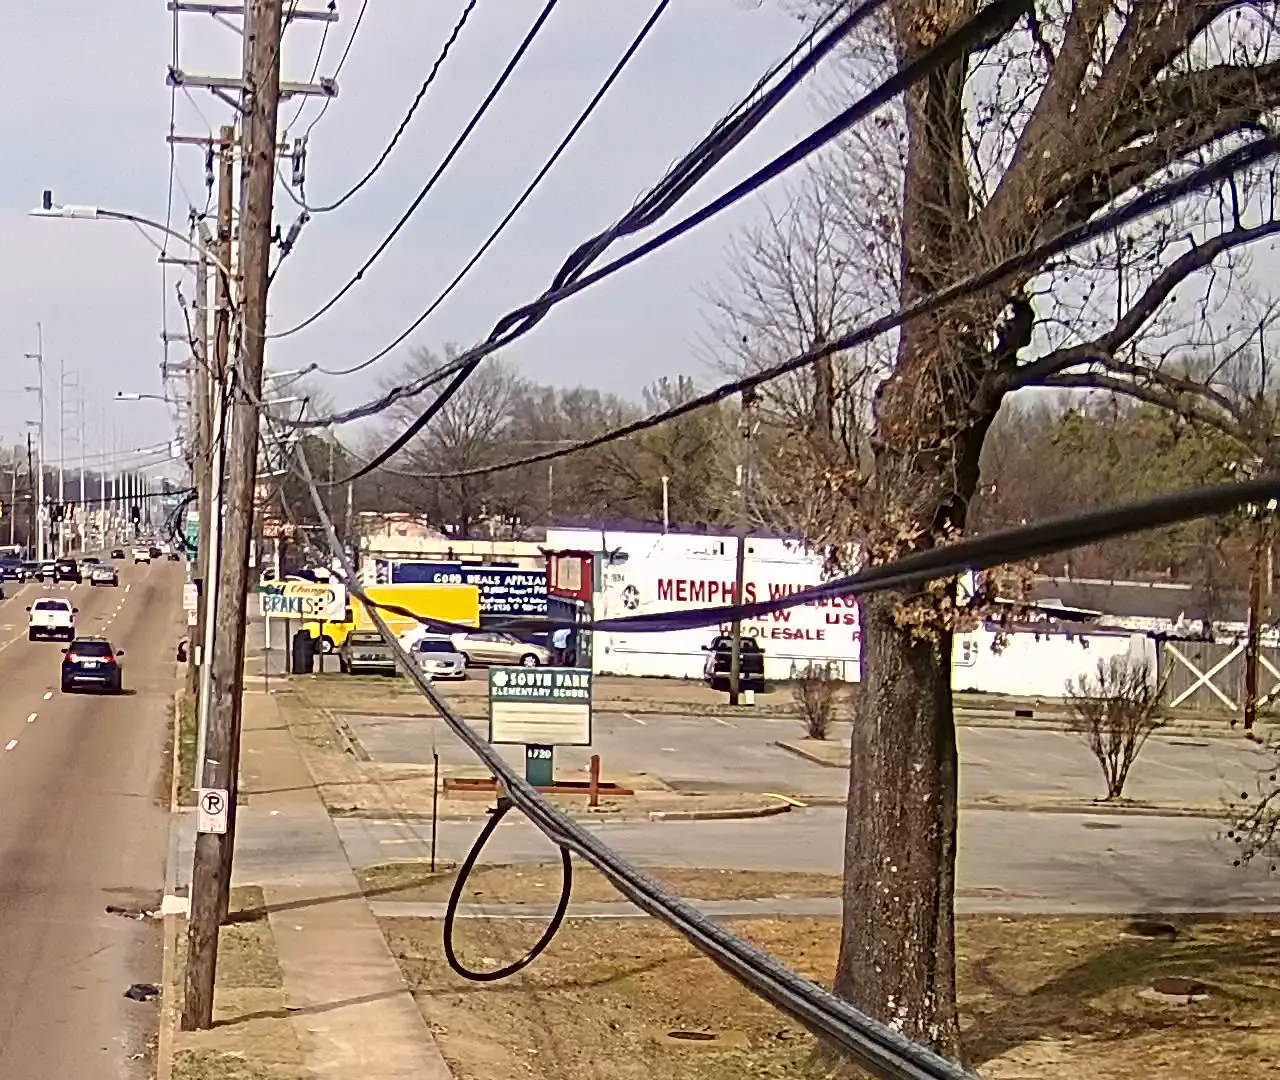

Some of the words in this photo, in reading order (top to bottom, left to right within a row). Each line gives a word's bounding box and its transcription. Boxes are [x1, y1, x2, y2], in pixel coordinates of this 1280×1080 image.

[658, 579, 757, 604] MEMPHS
[510, 672, 552, 687] SOUTH
[556, 674, 589, 688] PARK
[492, 687, 551, 697] ELEMENTARY
[553, 688, 589, 698] SCHOOL
